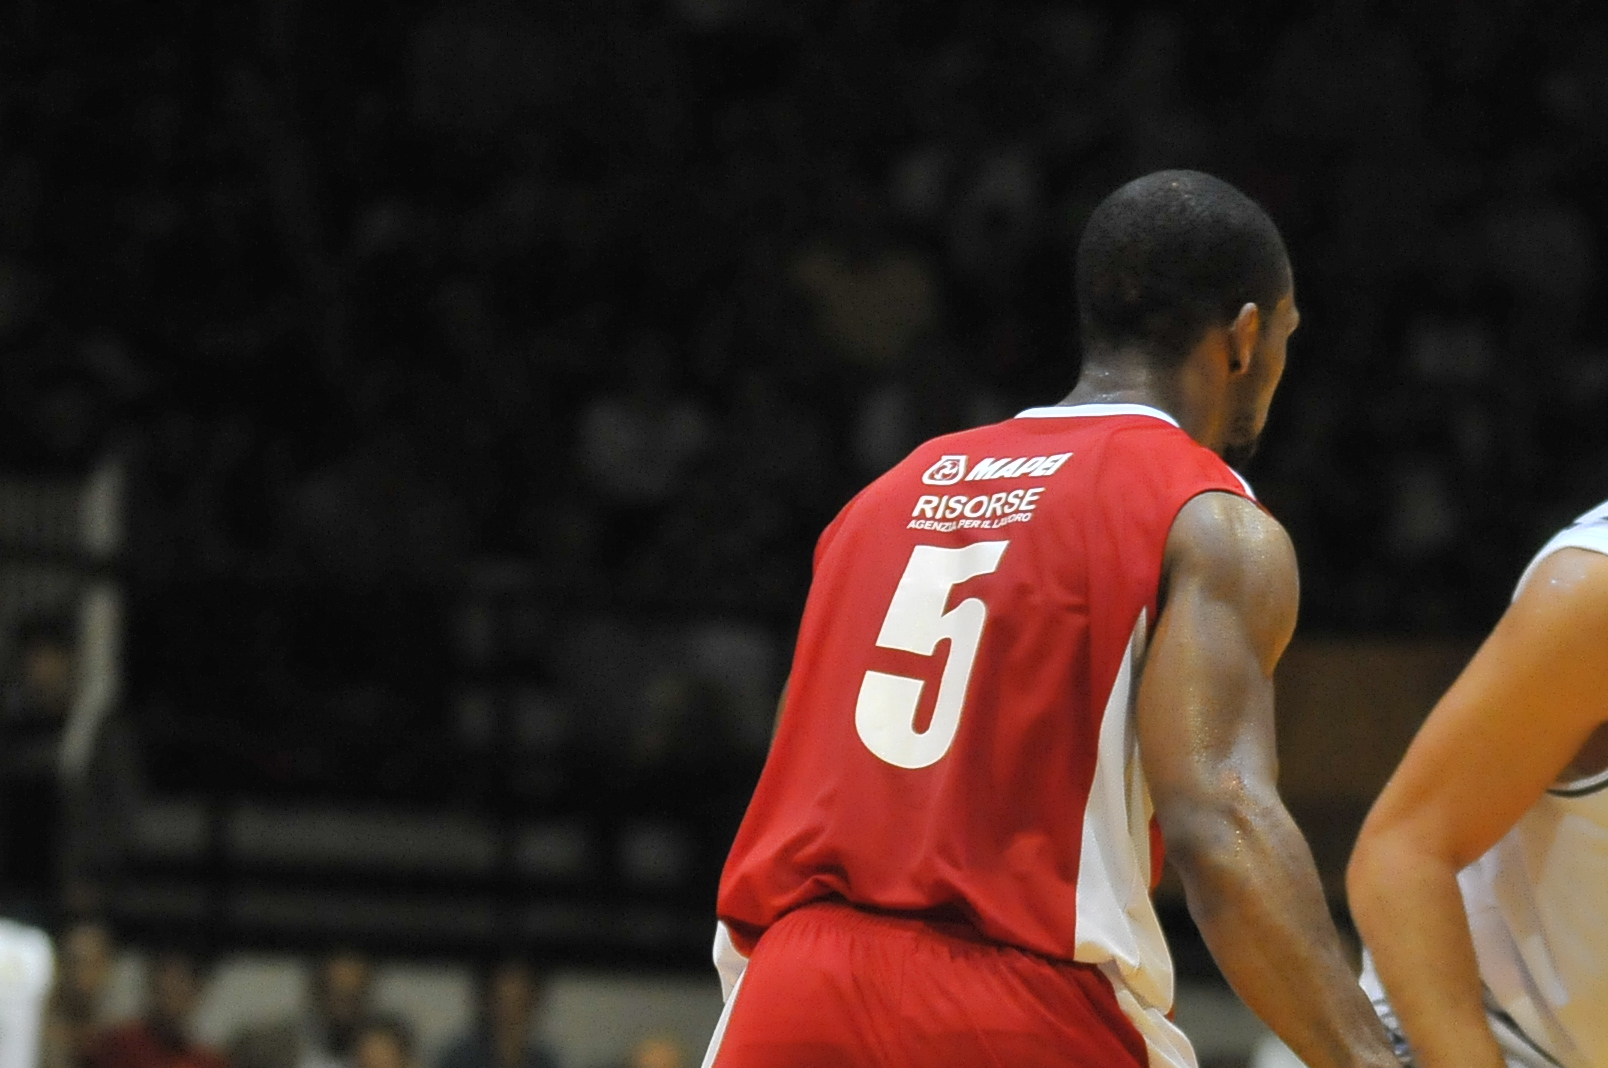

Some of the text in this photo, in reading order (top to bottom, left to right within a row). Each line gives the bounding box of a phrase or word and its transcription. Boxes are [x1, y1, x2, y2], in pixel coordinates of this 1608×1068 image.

[964, 452, 1073, 482] MAPEI
[911, 487, 1046, 519] RISORSE
[906, 519, 957, 532] AGENZIA
[957, 519, 980, 529] PER
[855, 540, 1010, 769] 5
